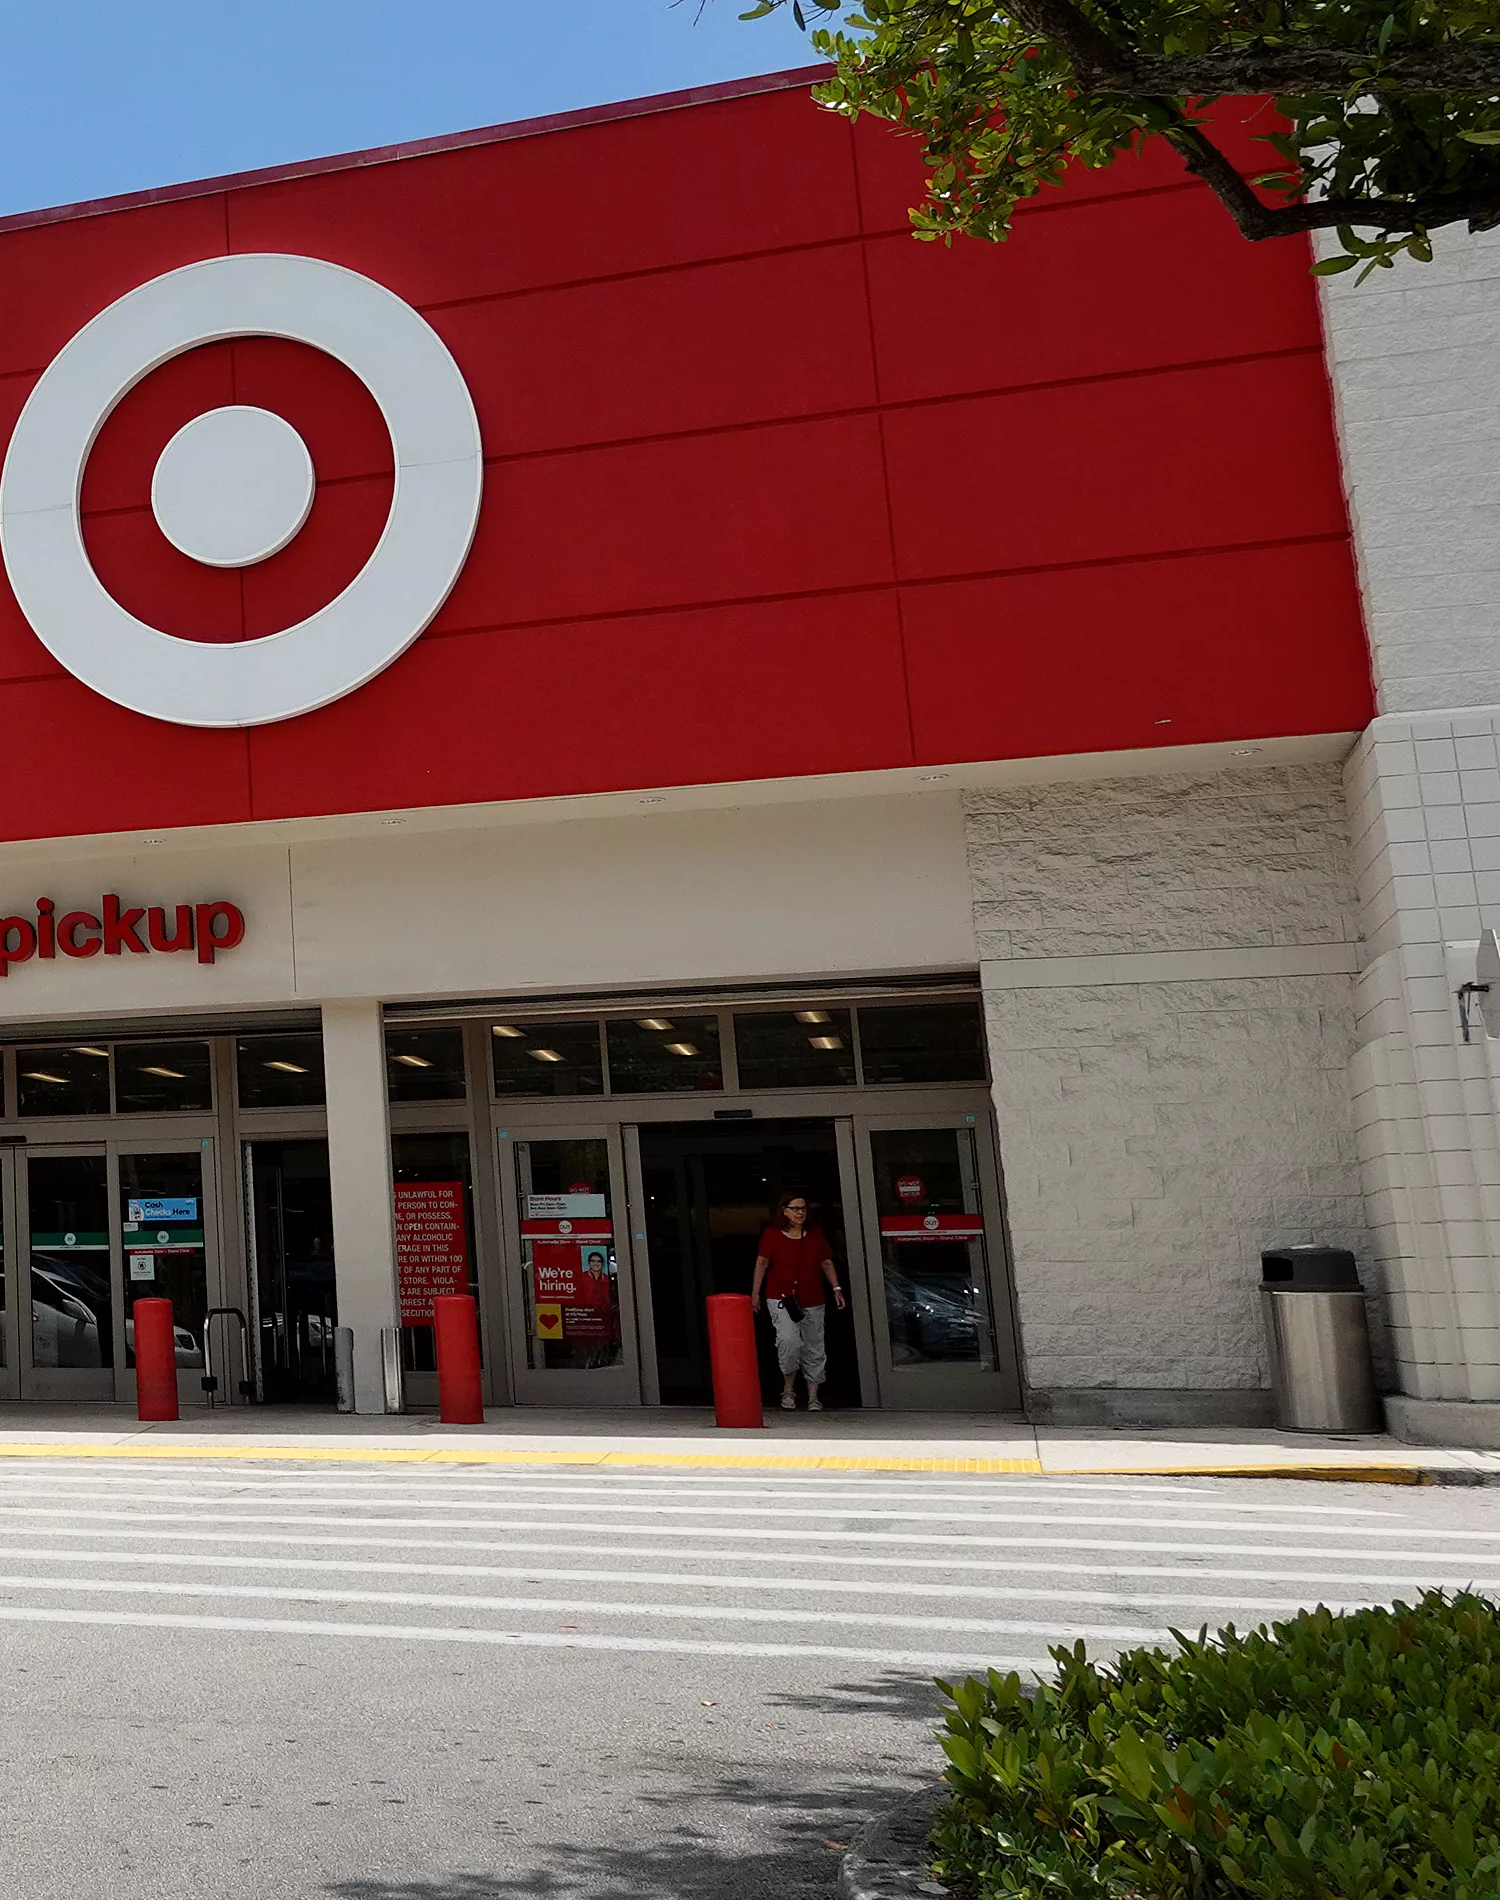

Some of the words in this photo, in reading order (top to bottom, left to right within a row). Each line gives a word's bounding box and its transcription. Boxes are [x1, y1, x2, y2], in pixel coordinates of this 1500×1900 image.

[398, 1191, 437, 1199] UNLAWFUL
[439, 1190, 453, 1198] FOR
[144, 1201, 163, 1209] Cash
[398, 1201, 426, 1209] PERSON
[429, 1201, 438, 1209] TO
[440, 1201, 458, 1209] CON-
[145, 1208, 172, 1216] Checks
[406, 1212, 416, 1220] OR
[404, 1223, 423, 1231] OPEN
[425, 1222, 460, 1230] CONTAIN-
[413, 1233, 453, 1241] ALCOHOLIC
[432, 1244, 449, 1252] THIS
[409, 1255, 419, 1263] OR
[421, 1255, 448, 1263] WITHIN
[404, 1266, 413, 1274] OF
[538, 1267, 573, 1279] We're
[540, 1280, 576, 1293] hiring.
